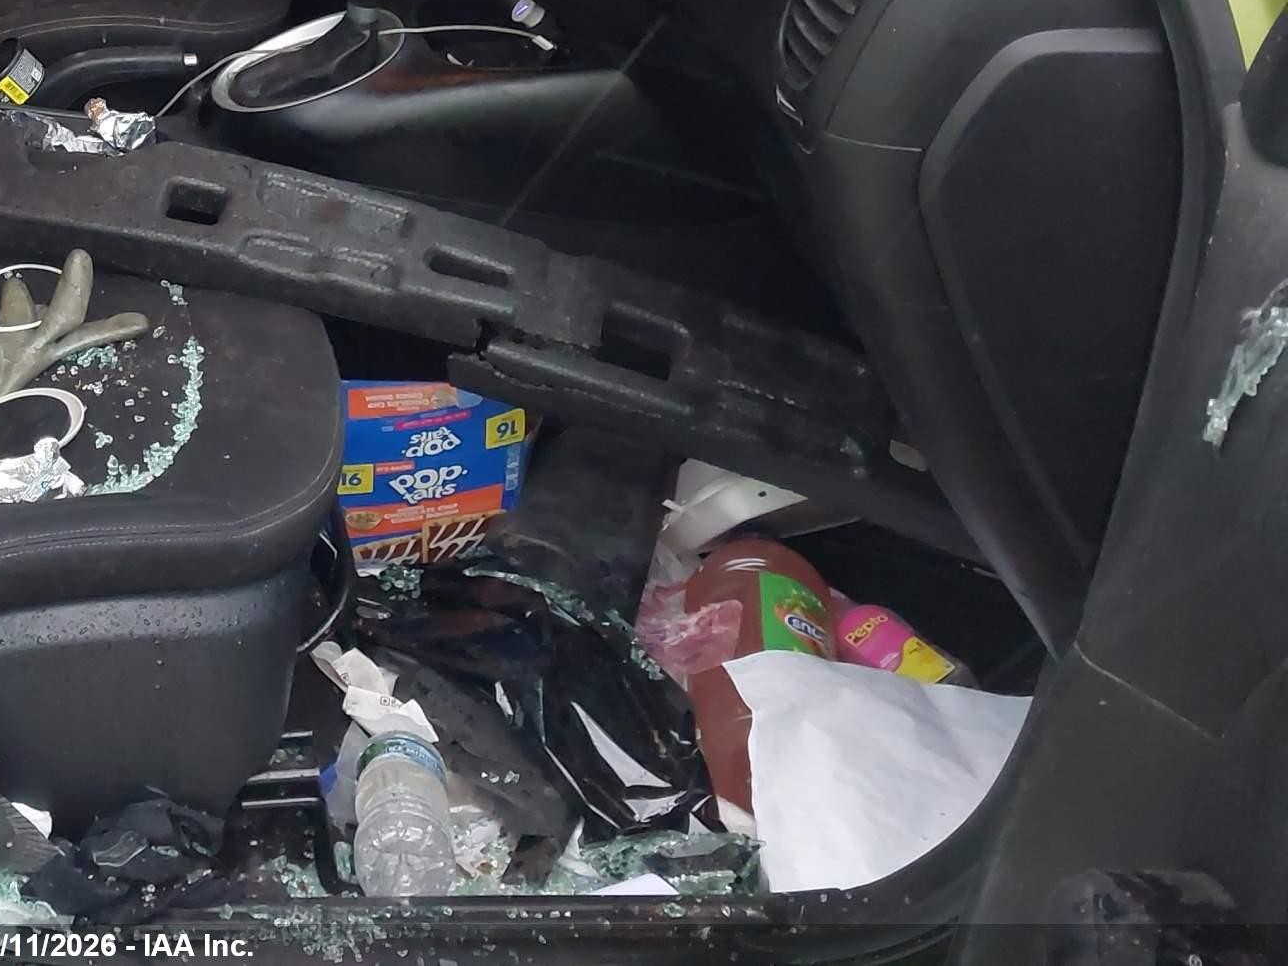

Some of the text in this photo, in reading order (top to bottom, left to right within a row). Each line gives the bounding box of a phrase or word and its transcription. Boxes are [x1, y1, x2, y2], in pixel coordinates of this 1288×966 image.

[497, 420, 519, 438] 16
[340, 472, 362, 486] 16
[844, 614, 889, 649] Pepto
